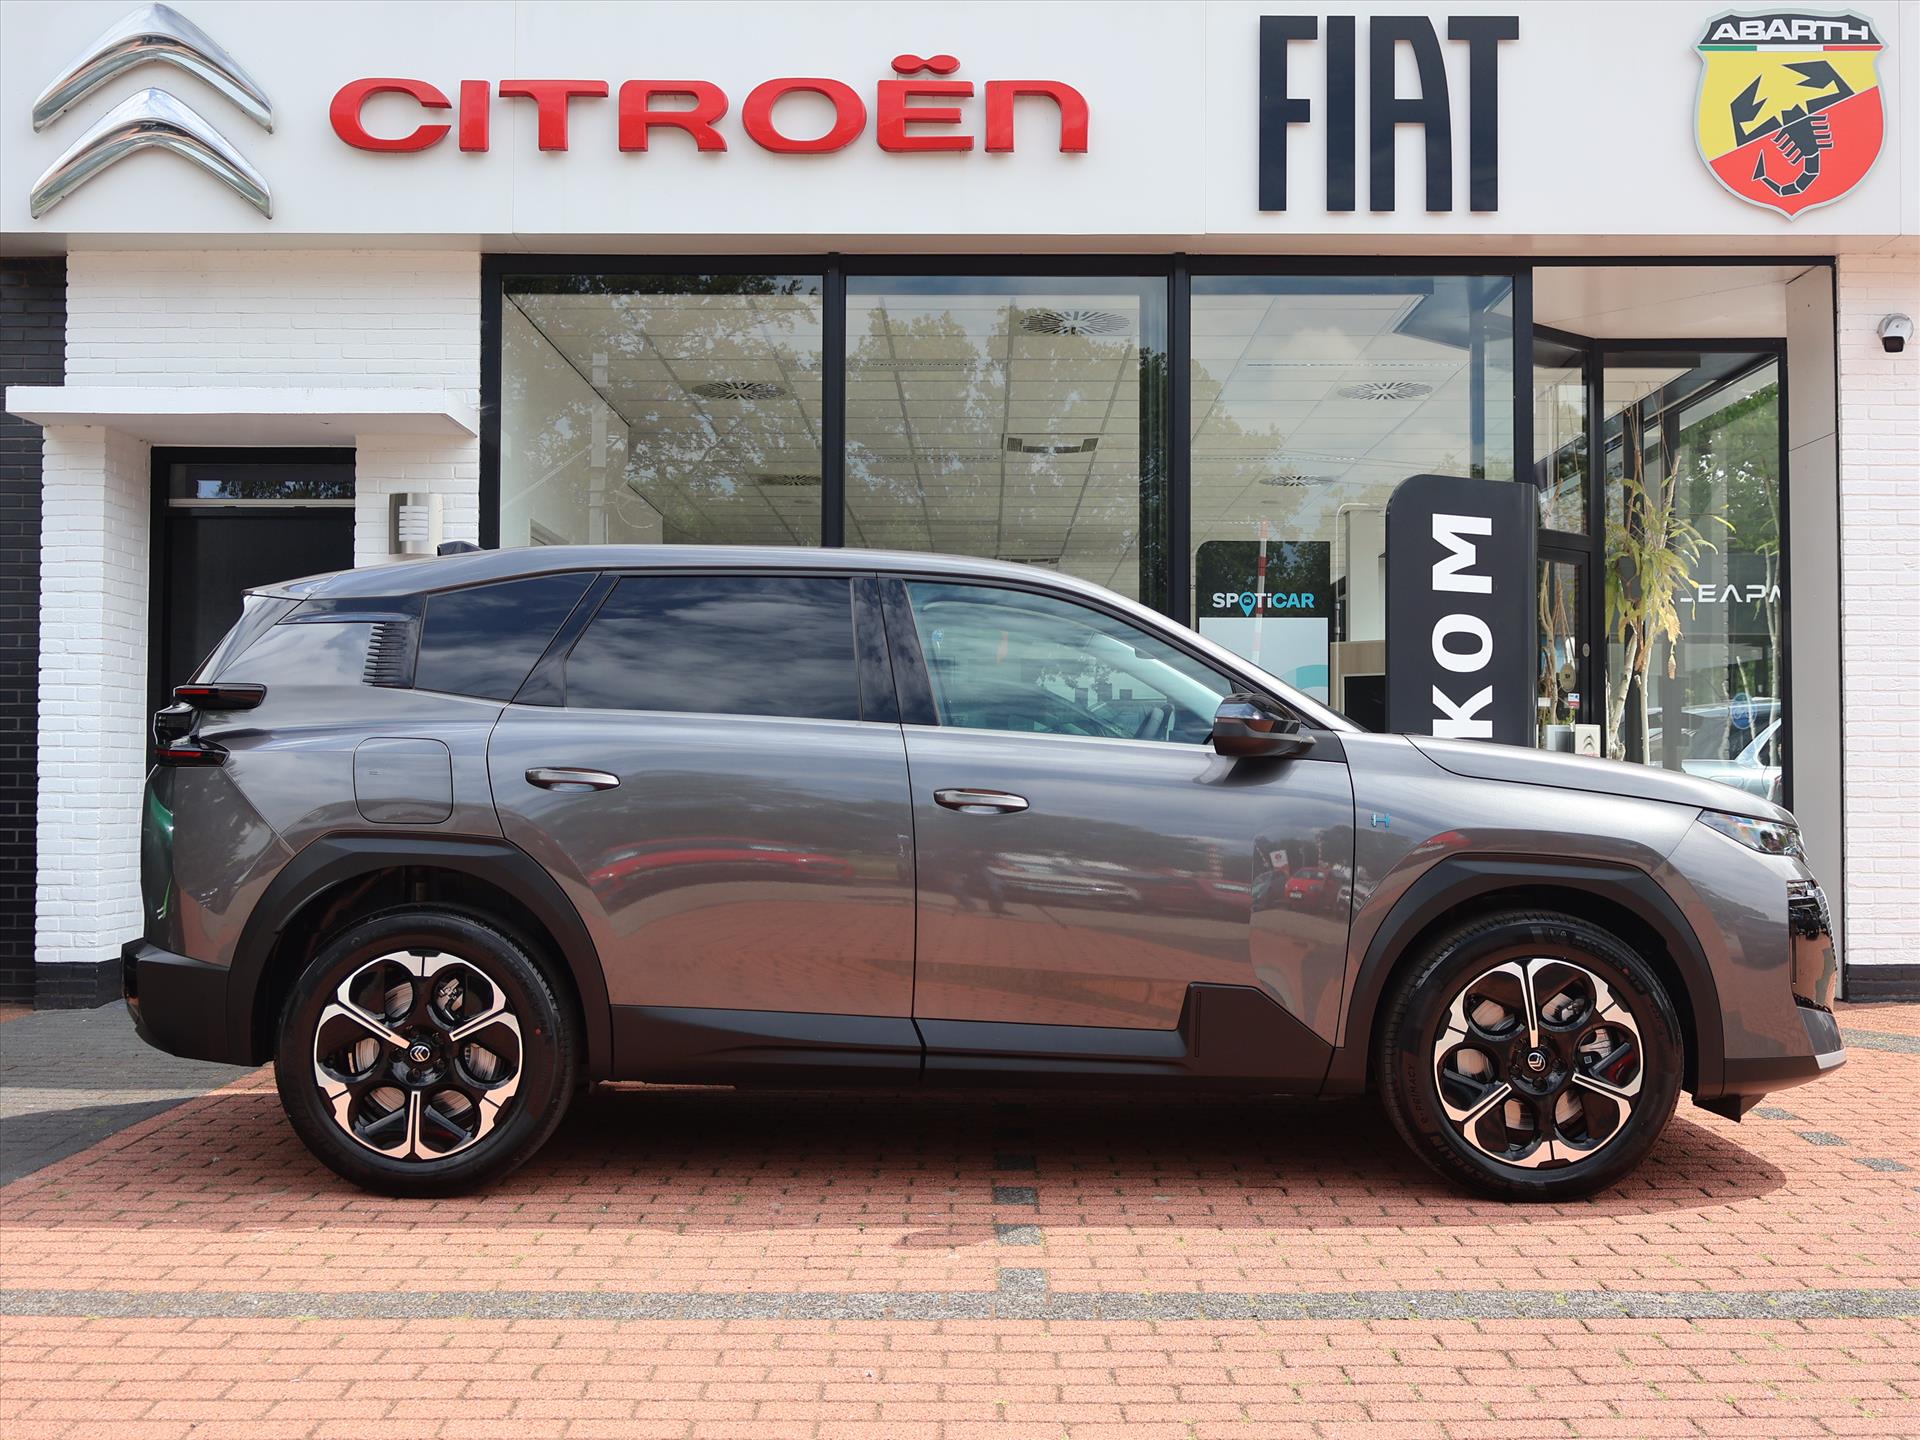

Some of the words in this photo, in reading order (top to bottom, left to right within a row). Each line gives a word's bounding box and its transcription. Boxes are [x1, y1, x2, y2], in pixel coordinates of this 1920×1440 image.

[1711, 19, 1869, 41] ABARTH
[330, 54, 1089, 154] CITROËN
[1259, 16, 1519, 211] FIAT
[1432, 513, 1493, 738] KOM
